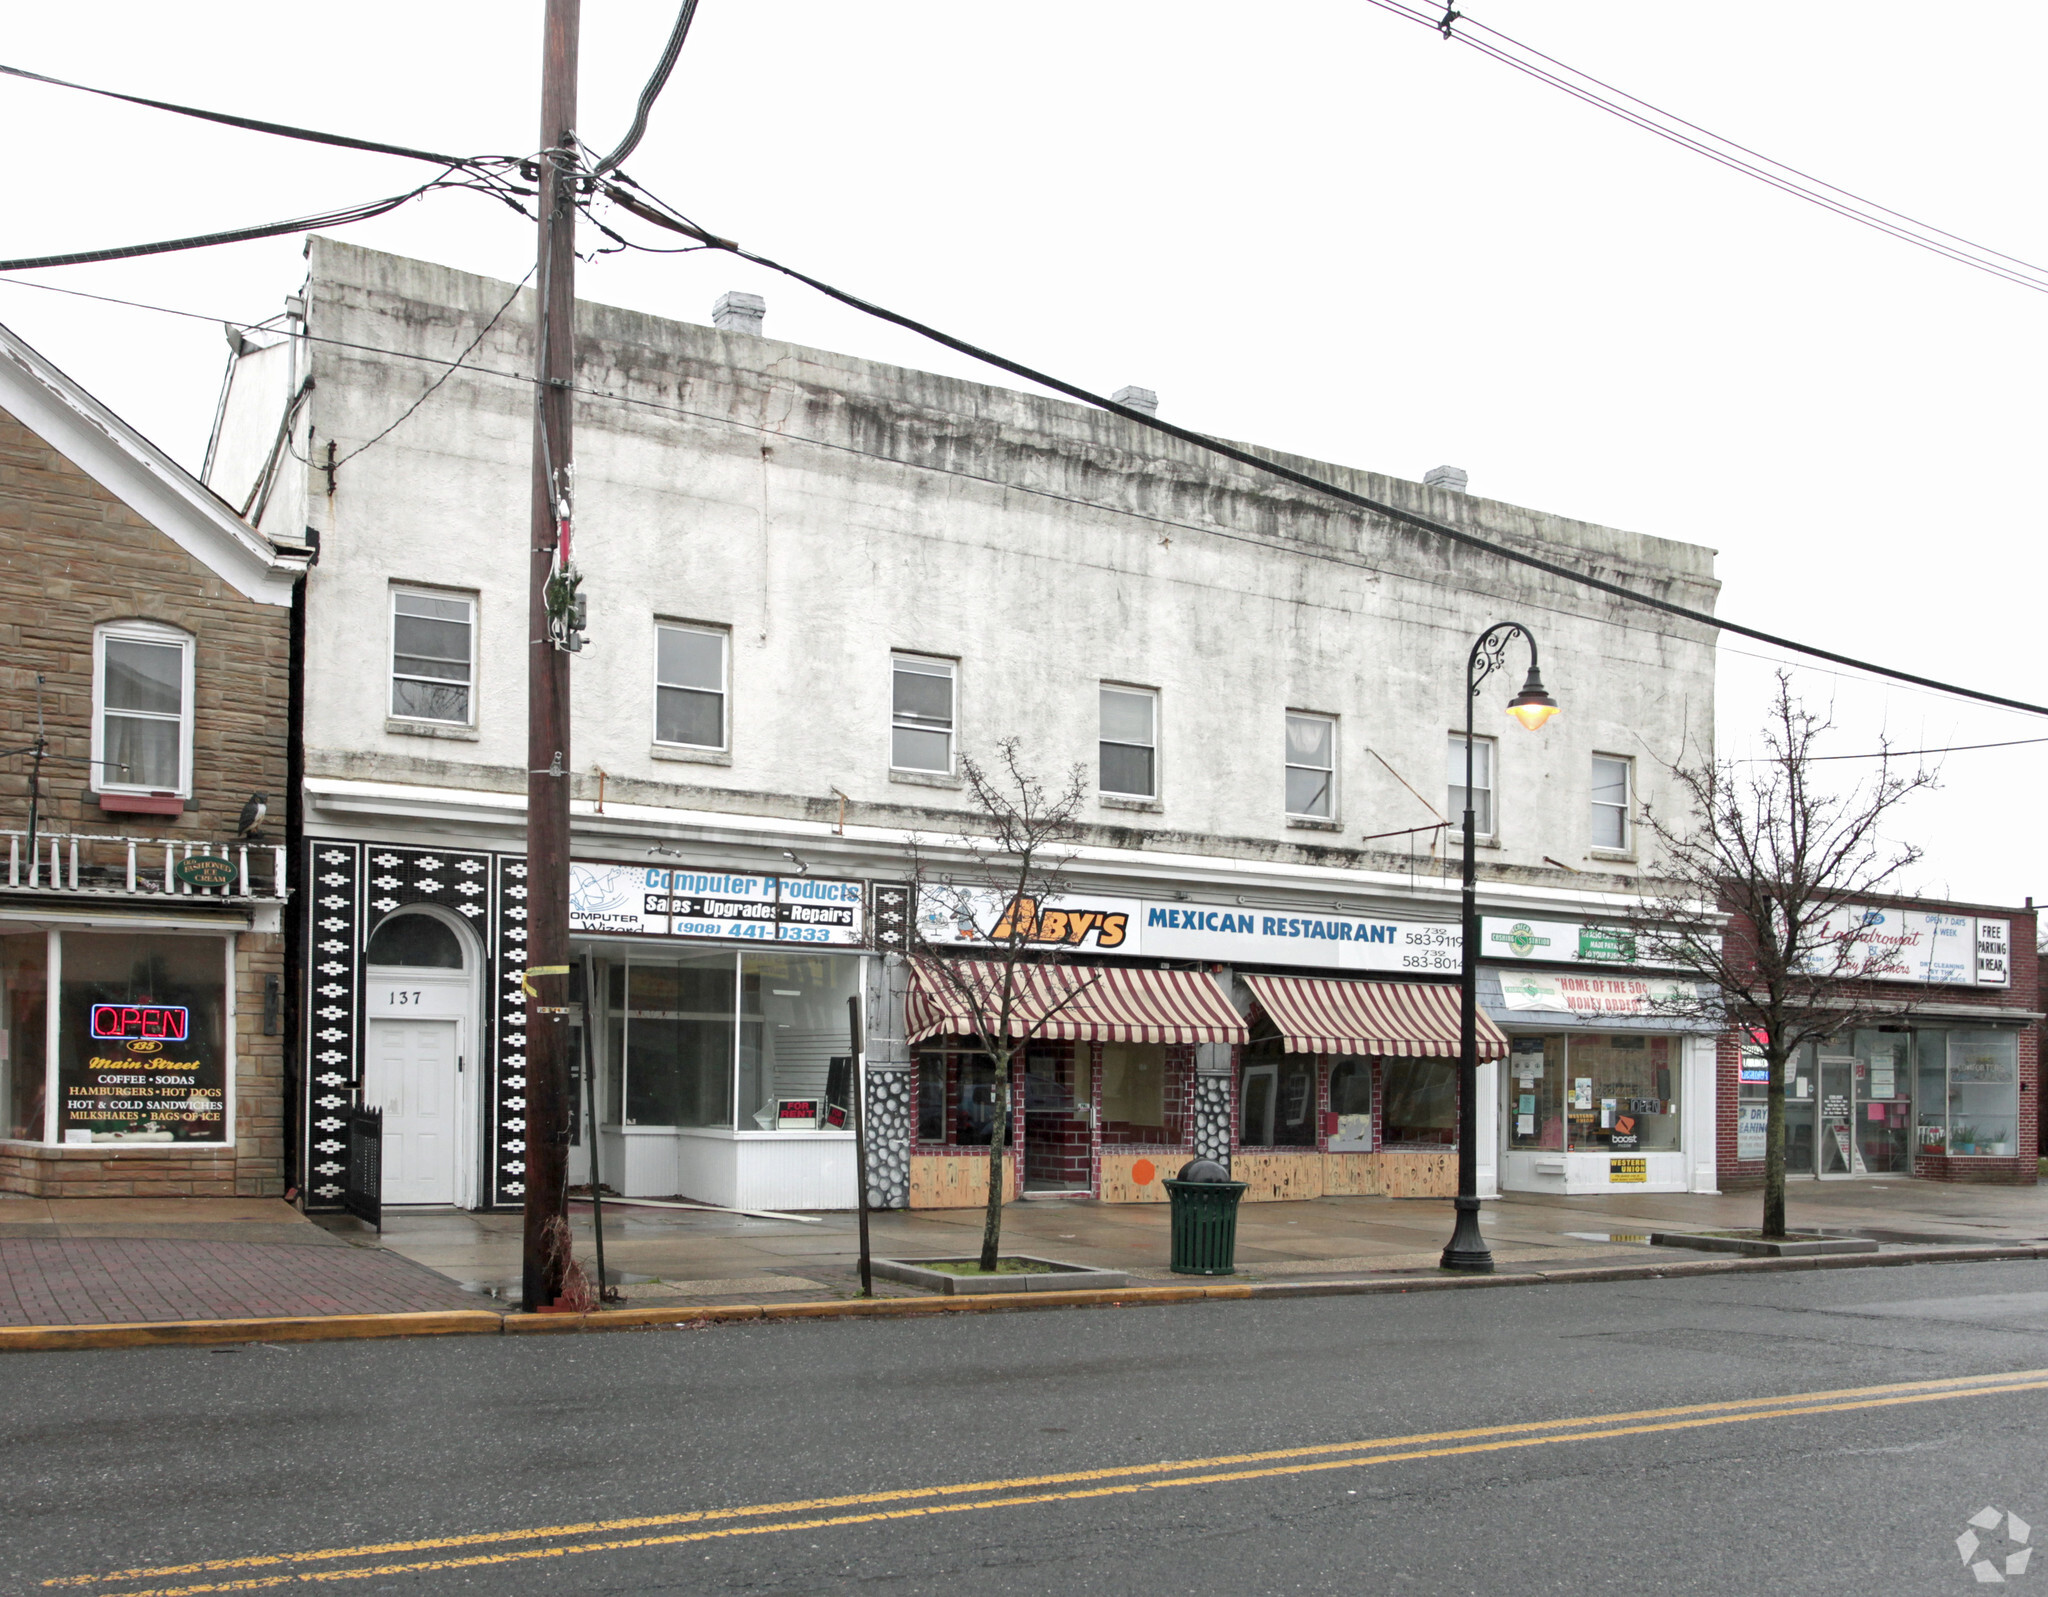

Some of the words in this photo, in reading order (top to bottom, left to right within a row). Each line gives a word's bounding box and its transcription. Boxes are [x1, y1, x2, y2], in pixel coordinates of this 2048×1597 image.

[184, 862, 232, 872] FASHIONED
[645, 869, 757, 894] Computer
[763, 877, 859, 902] Products
[646, 896, 691, 913] Sales
[704, 900, 776, 918] Upgrades
[791, 906, 852, 923] Repairs
[570, 912, 638, 922] OMPUTER
[1926, 916, 1942, 924] OPEN
[1950, 918, 1966, 926] DAYS
[678, 922, 721, 934] (908)
[728, 924, 830, 942] 441-0333
[1148, 908, 1254, 934] MEXICAN
[1262, 916, 1397, 944] RESTAURANT
[1514, 924, 1530, 932] CHECK
[1982, 926, 2001, 938] FREE
[1820, 920, 1924, 946] Laundromat
[1406, 933, 1463, 948] 583-9119
[1492, 934, 1514, 942] CASHING
[1528, 937, 1550, 946] STATION
[1978, 941, 2006, 954] PARKING
[1864, 957, 1910, 974] Cleaners
[1934, 962, 1964, 970] CLEANING
[1978, 958, 1984, 970] IN
[1986, 959, 2002, 971] REAR
[1555, 977, 1590, 992] "HOME
[1593, 980, 1604, 992] OF
[1606, 980, 1626, 994] THE
[390, 991, 421, 1005] 137
[1567, 996, 1600, 1010] MONEY
[94, 1006, 184, 1038] OPEN
[132, 1042, 156, 1050] 135
[89, 1057, 142, 1070] Main
[144, 1058, 200, 1070] Street
[98, 1075, 146, 1084] COFFEE
[155, 1076, 195, 1084] SODAS
[69, 1087, 154, 1096] HAMBURGERS
[161, 1088, 187, 1096] HOT
[190, 1088, 222, 1097] DOGS
[68, 1100, 94, 1109] HOT
[98, 1101, 106, 1109] &
[110, 1101, 143, 1110] COLD
[146, 1102, 222, 1110] SANDWICHES
[787, 1102, 810, 1110] FOR
[1632, 1100, 1660, 1114] OPEN
[70, 1111, 138, 1120] MILKSHAKES
[150, 1112, 180, 1120] BAGS
[780, 1110, 815, 1118] RENT
[1750, 1109, 1768, 1120] DRY
[1612, 1135, 1637, 1143] boost
